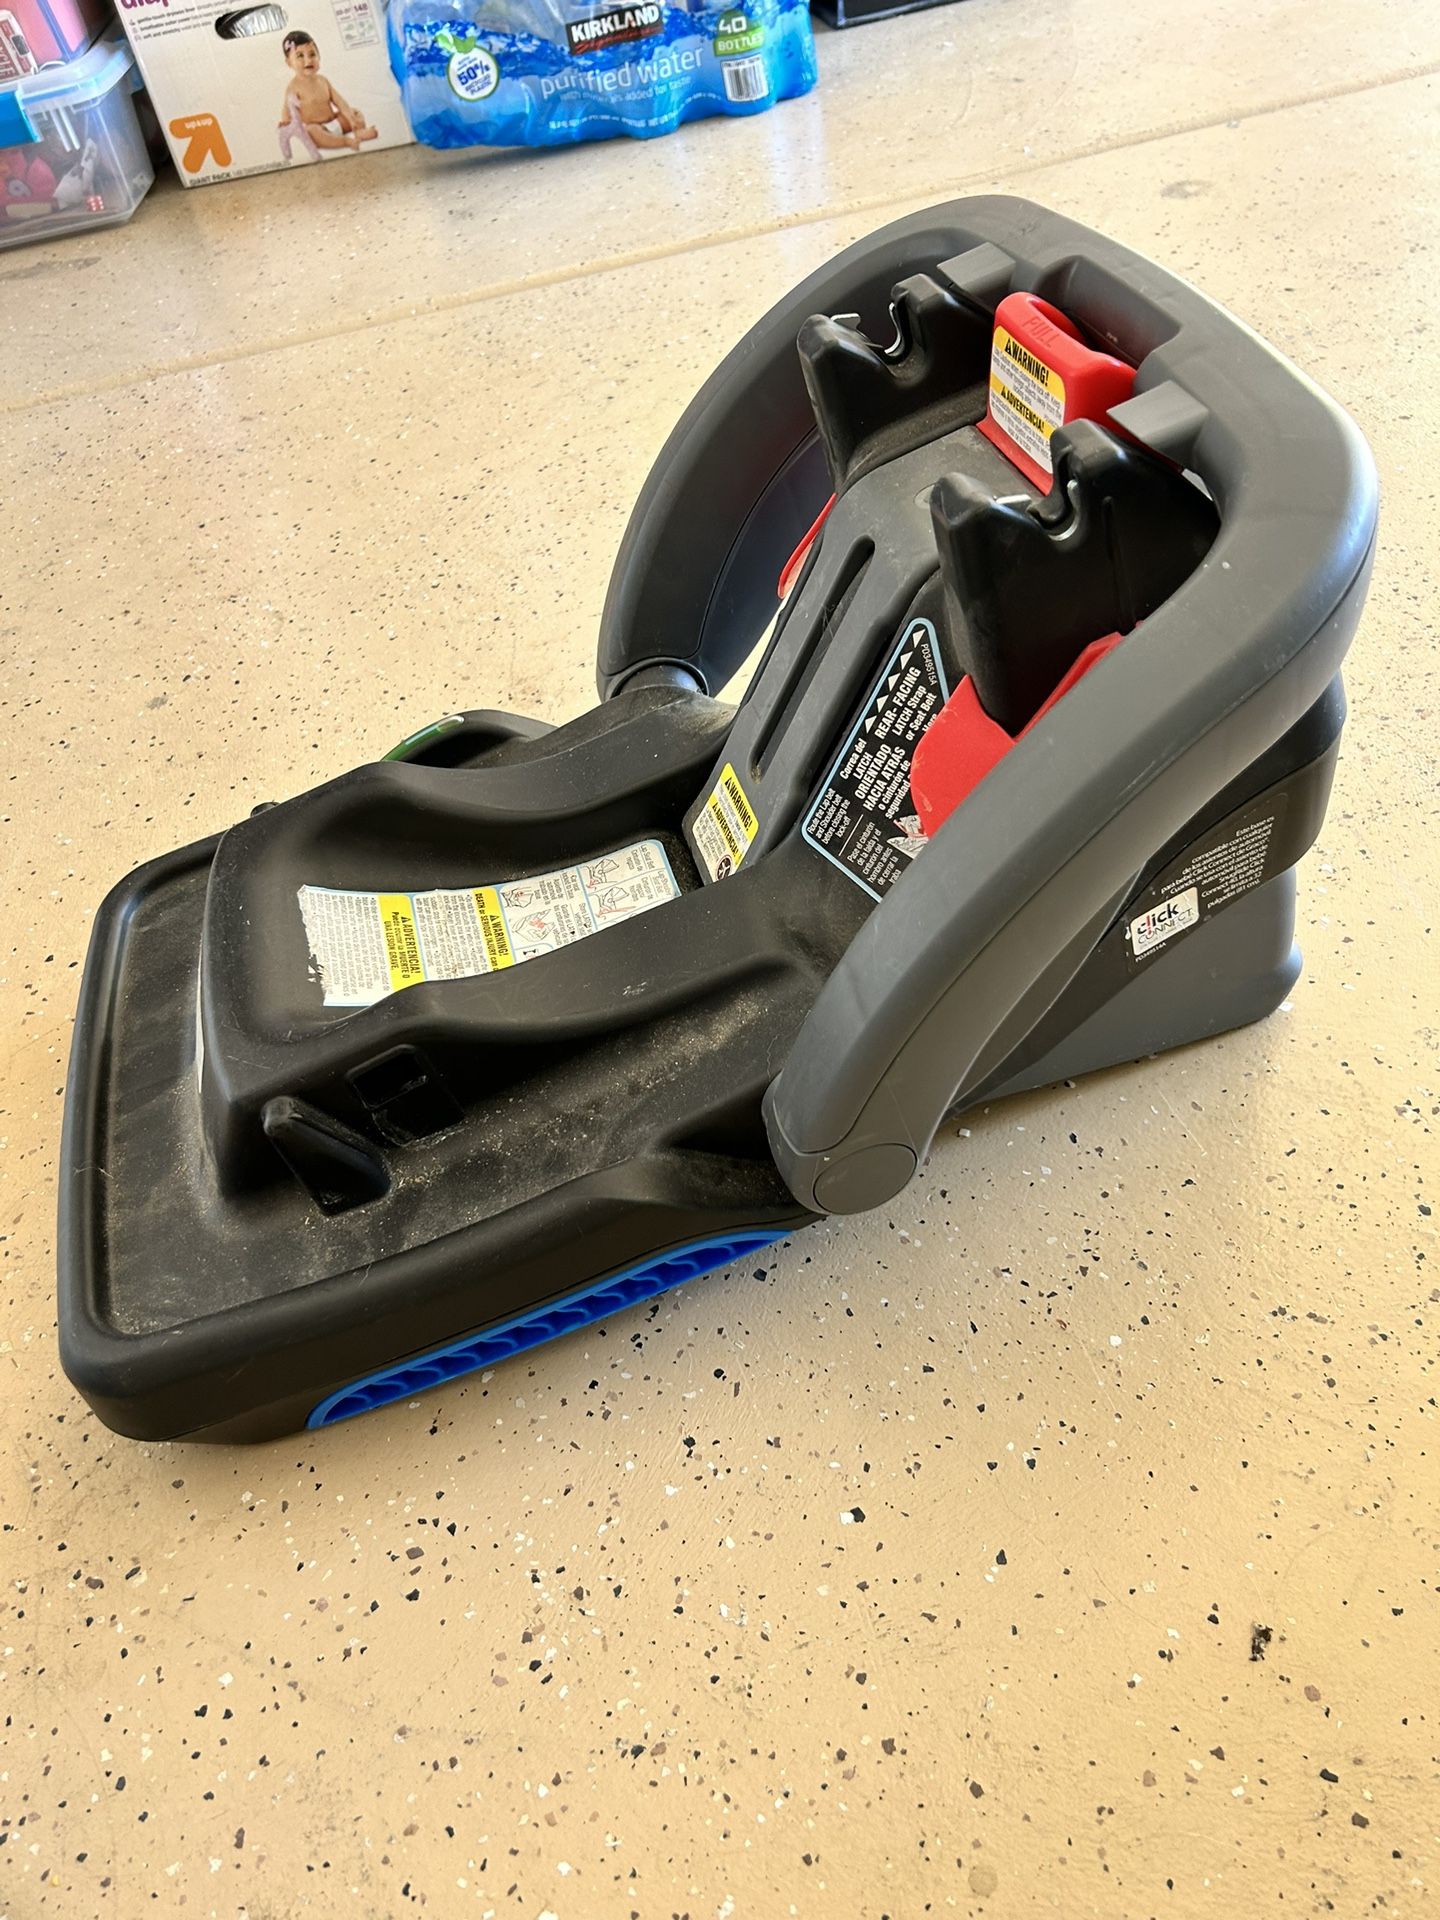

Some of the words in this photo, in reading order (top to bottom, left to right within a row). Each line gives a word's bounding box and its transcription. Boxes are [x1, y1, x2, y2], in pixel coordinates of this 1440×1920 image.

[571, 5, 660, 42] KIRKLAND
[718, 16, 746, 35] 40
[718, 32, 765, 53] BOTTLES
[457, 61, 491, 86] 50%
[540, 66, 636, 99] purified
[638, 48, 704, 81] water
[1010, 340, 1050, 387] WARNING!
[1006, 389, 1045, 434] ADVERTENCIA!
[873, 704, 900, 739] REAR-
[891, 665, 922, 706] FACING
[890, 707, 913, 735] LATCH
[905, 684, 928, 710] Strap
[918, 690, 937, 711] Belt
[908, 709, 926, 731] Seat
[903, 729, 916, 741] or
[838, 752, 860, 779] Correa
[852, 738, 867, 753] del
[852, 751, 873, 779] LATCH
[853, 742, 892, 799] ORIENTADO
[898, 758, 911, 772] de
[862, 778, 888, 811] HACIA
[877, 744, 906, 780] ATRÁS
[879, 769, 905, 804] cinturón
[729, 782, 753, 831] WARNING!
[806, 815, 820, 834] Route
[814, 807, 824, 819] the
[819, 796, 831, 811] Lap
[825, 786, 836, 800] belt
[831, 792, 843, 807] belt
[877, 802, 886, 810] o
[883, 779, 912, 820] seguridad
[819, 802, 837, 829] Shoulder
[820, 824, 835, 845] before
[830, 805, 847, 830] closing
[840, 797, 850, 810] the
[834, 814, 851, 838] lock-off
[716, 807, 739, 857] ADVERTENCIA!
[814, 825, 825, 839] and
[871, 833, 879, 842] y
[873, 827, 881, 837] el
[846, 845, 860, 863] Pase
[854, 840, 863, 850] el
[860, 849, 868, 859] la
[873, 841, 883, 854] del
[855, 855, 865, 867] de
[866, 858, 884, 884] hombro
[879, 845, 892, 864] antes
[876, 874, 885, 886] de
[881, 860, 894, 879] cerrar
[889, 853, 898, 864] la
[1161, 883, 1174, 893] para
[1192, 865, 1207, 876] Click
[1208, 852, 1235, 867] Connect
[1236, 847, 1244, 855] de
[1249, 857, 1264, 868] Click
[888, 866, 900, 884] traba
[1170, 879, 1195, 893] Cuando
[474, 893, 485, 908] DEATH
[1201, 881, 1228, 897] Connect
[480, 915, 492, 936] SERIOUS
[1137, 903, 1179, 935] click
[1138, 908, 1193, 945] CONNECT
[391, 911, 401, 926] Puede
[398, 951, 408, 972] MUERTE
[402, 923, 420, 974] ADVERTENCIA!
[485, 937, 496, 955] INJURY
[491, 920, 508, 956] WARNING!
[489, 956, 498, 966] can
